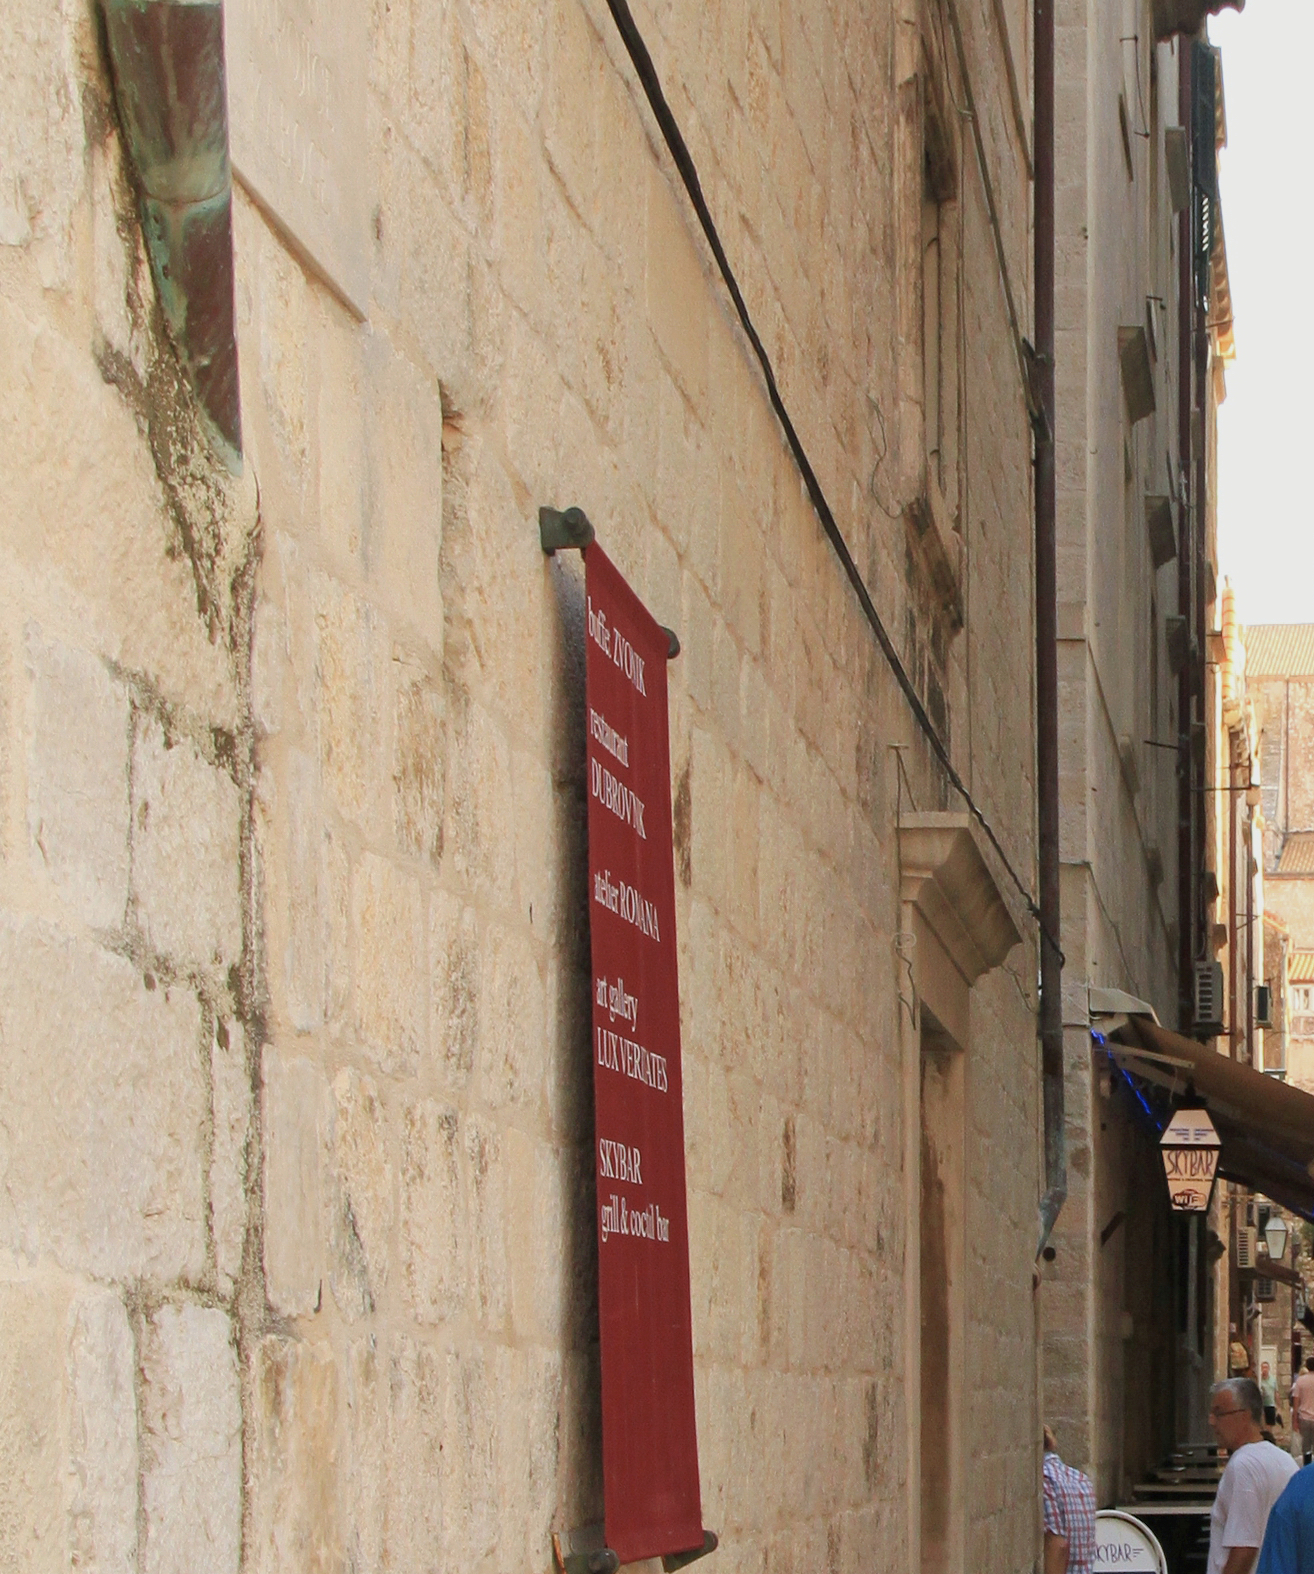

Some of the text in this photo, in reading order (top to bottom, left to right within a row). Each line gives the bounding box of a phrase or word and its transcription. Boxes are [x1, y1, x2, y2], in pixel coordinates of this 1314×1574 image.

[613, 627, 647, 698] ZVONIK
[590, 707, 629, 768] restaurant
[591, 756, 647, 840] DUBROVNIK
[596, 975, 638, 1033] art gallery
[597, 1026, 619, 1072] LUX
[599, 1137, 643, 1185] SKYBAR
[1166, 1149, 1213, 1177] SKYBAR
[601, 1194, 619, 1243] grill
[656, 1205, 670, 1243] bar
